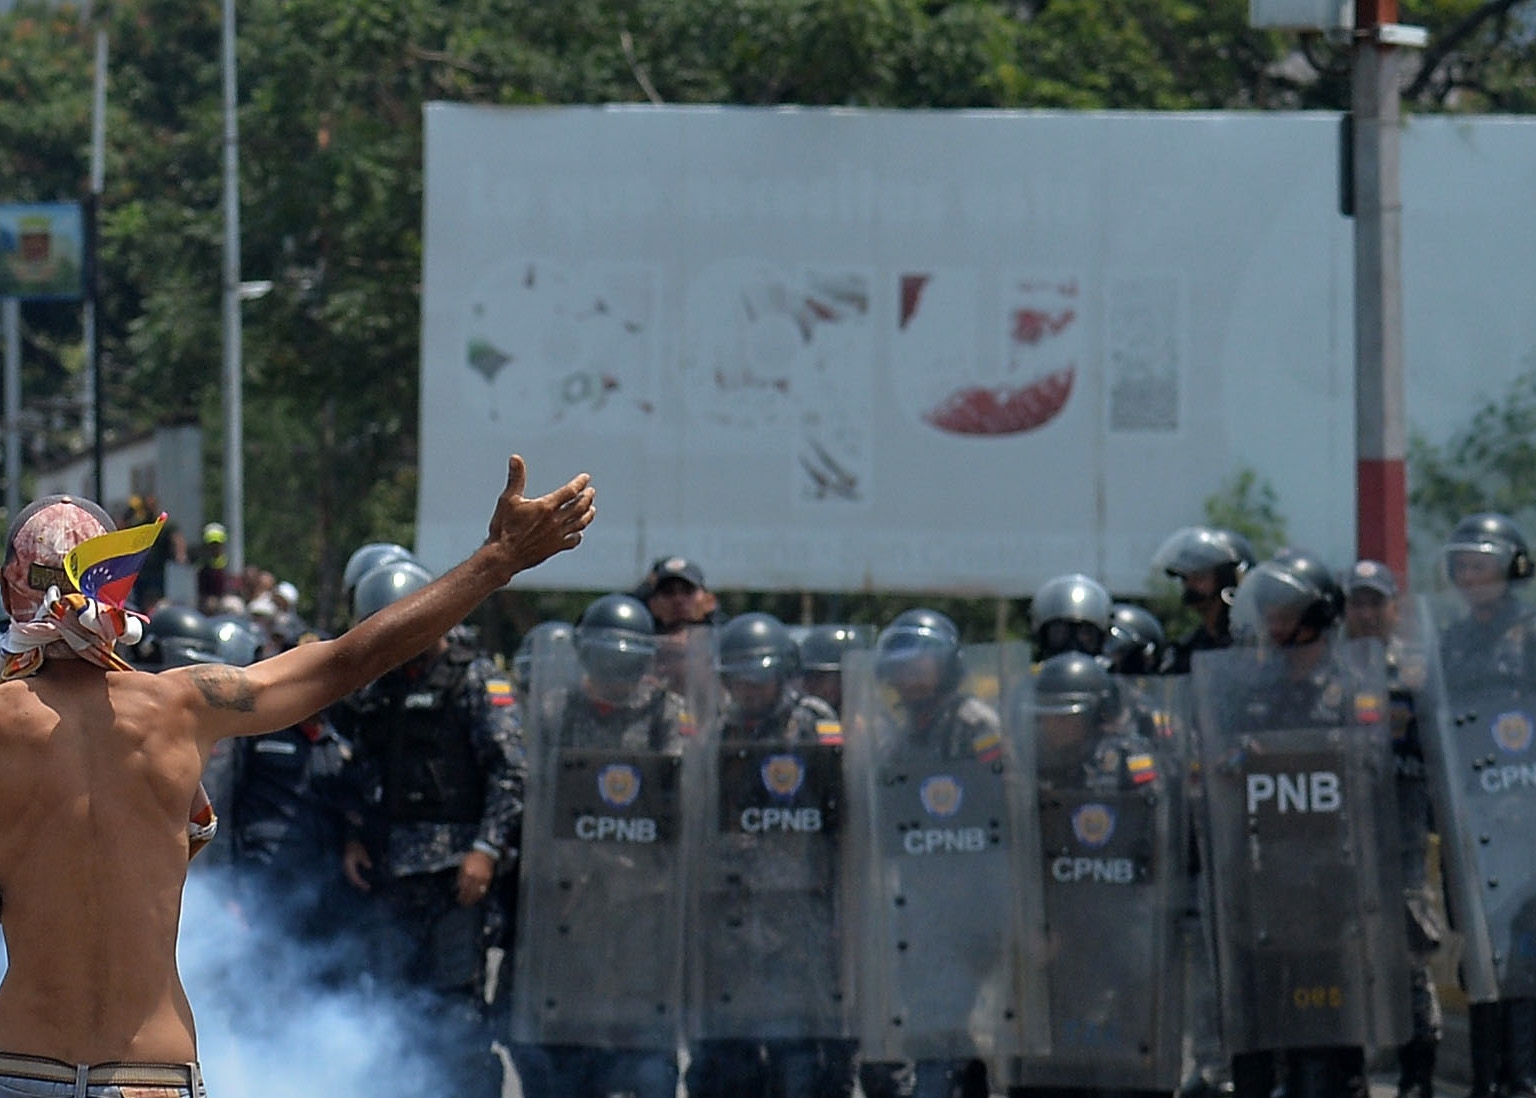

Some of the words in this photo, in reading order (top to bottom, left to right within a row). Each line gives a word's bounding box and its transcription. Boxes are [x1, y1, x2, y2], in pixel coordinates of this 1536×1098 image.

[1246, 771, 1341, 814] PNB
[575, 815, 658, 843] CPNB
[740, 807, 823, 832] CPNB
[903, 827, 985, 855] CPNB
[1051, 856, 1134, 884] CPNB
